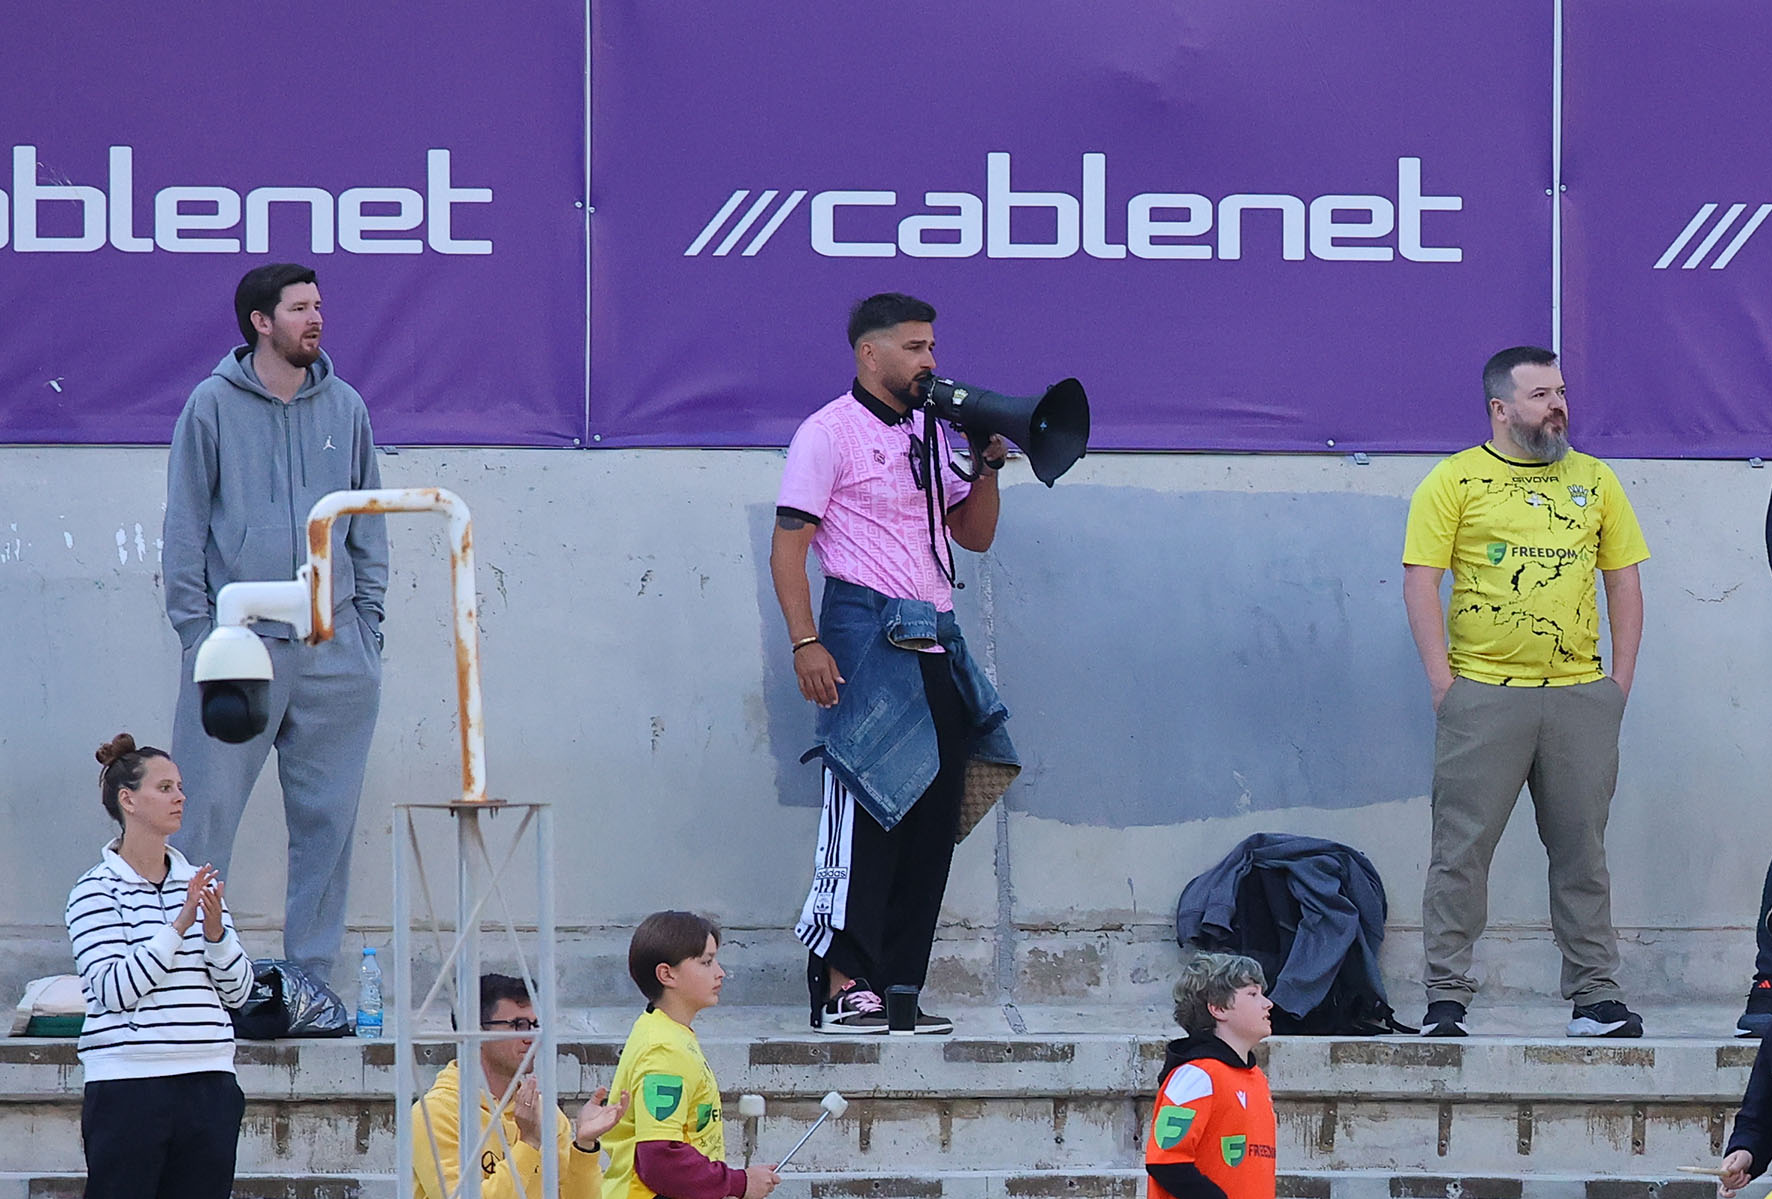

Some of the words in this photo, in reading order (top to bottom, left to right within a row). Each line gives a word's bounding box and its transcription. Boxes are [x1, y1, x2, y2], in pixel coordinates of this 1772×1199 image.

[0, 146, 492, 254] blenet
[812, 152, 1462, 261] cablenet
[1511, 546, 1578, 559] FREEDOM
[817, 869, 847, 879] adidas
